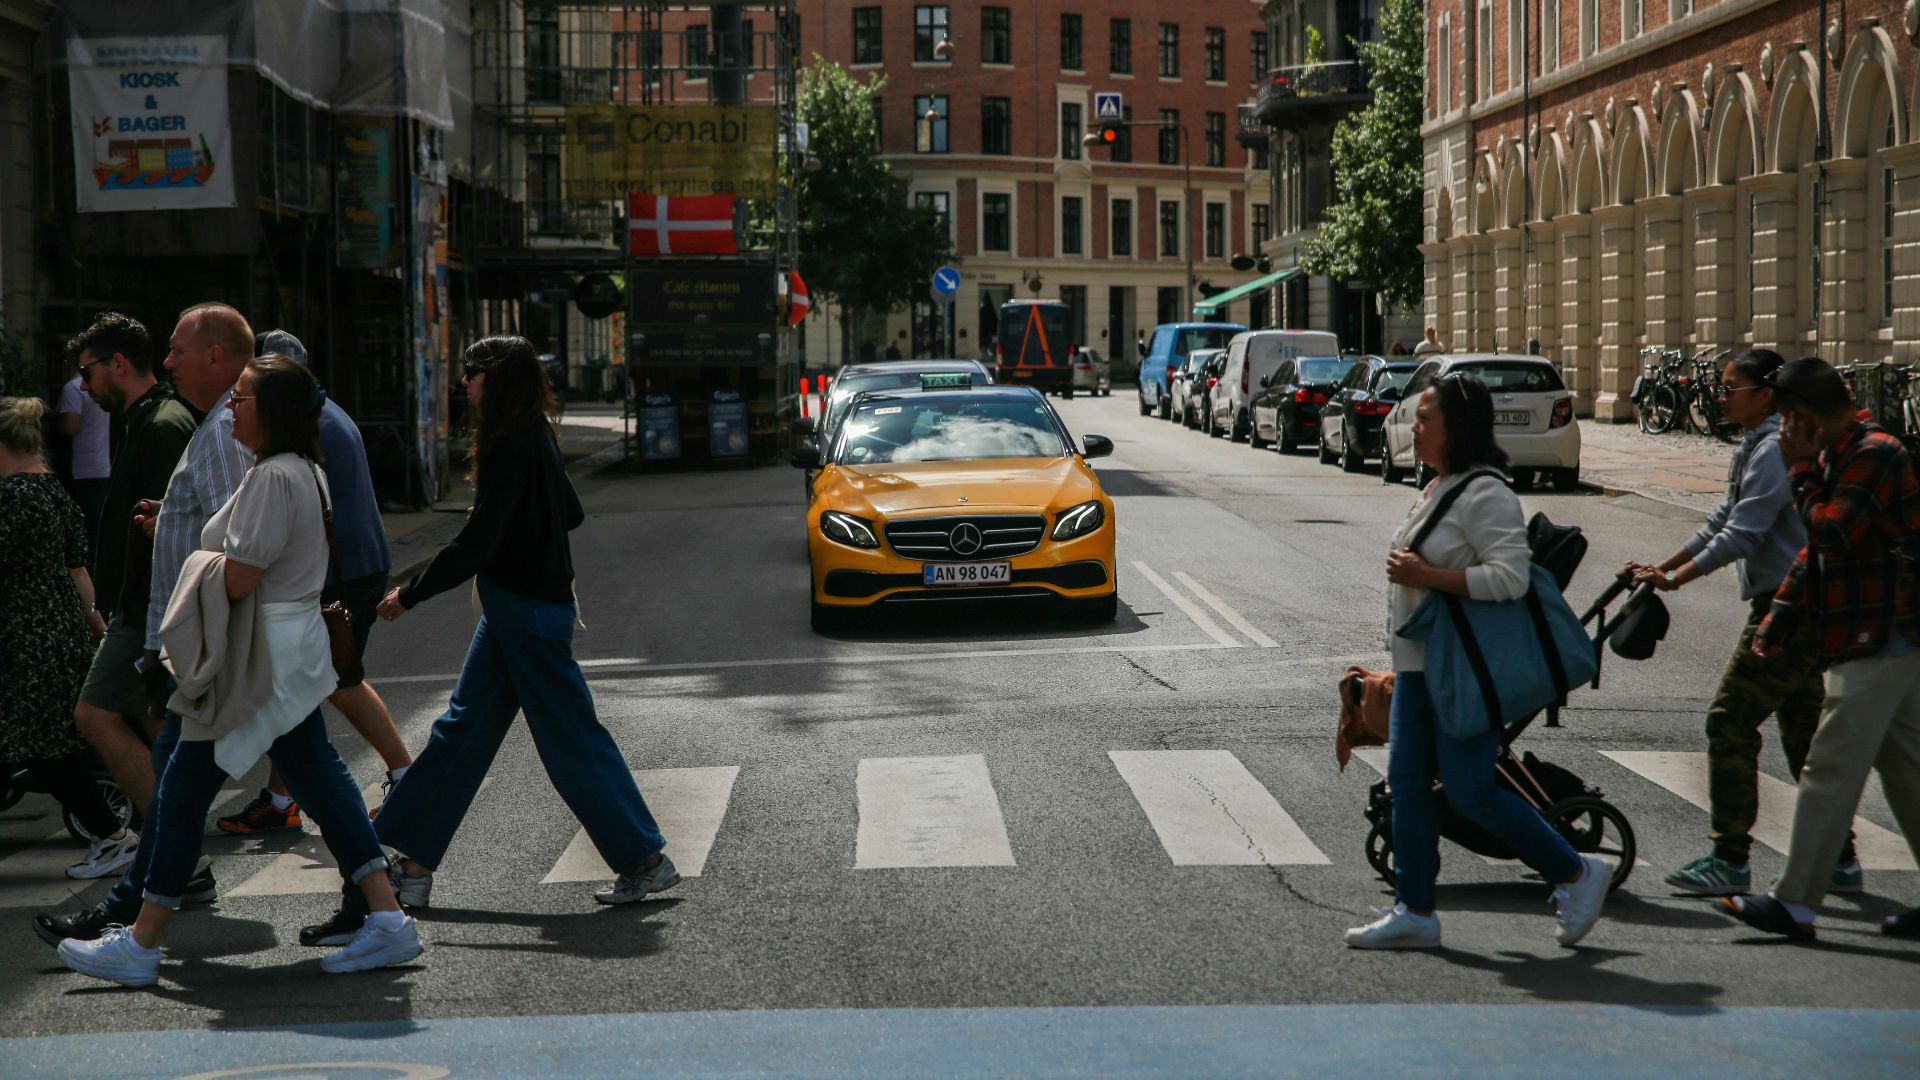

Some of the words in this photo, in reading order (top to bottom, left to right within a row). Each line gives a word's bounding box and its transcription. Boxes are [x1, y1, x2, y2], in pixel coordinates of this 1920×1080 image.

[120, 72, 180, 88] KIOSK
[144, 94, 158, 109] &
[118, 115, 186, 132] BAGER
[626, 113, 748, 144] Conabi
[926, 376, 959, 386] TAXI
[1501, 414, 1509, 422] 31
[1512, 414, 1528, 422] 402
[935, 566, 955, 581] AN
[959, 566, 977, 581] 98
[980, 565, 1007, 579] 047
